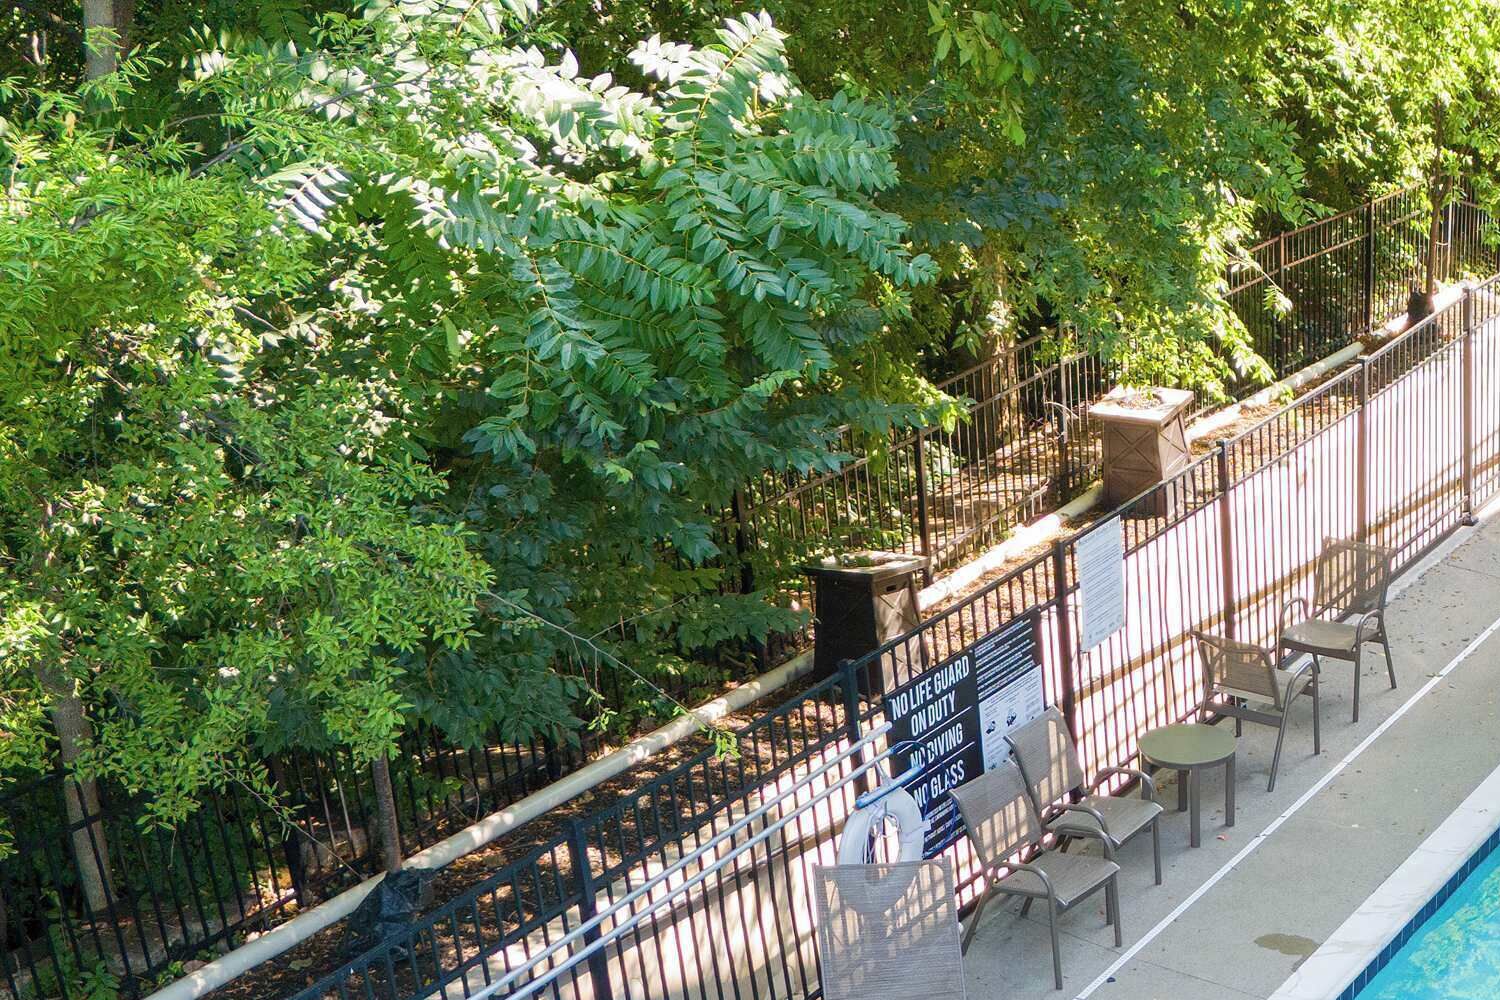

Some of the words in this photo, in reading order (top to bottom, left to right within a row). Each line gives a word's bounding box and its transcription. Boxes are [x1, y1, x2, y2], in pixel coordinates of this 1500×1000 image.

[891, 693, 908, 721] NO
[909, 678, 933, 709] LIFE
[934, 655, 970, 696] GUARD
[911, 708, 927, 737] ON
[928, 690, 956, 728] DUTY
[910, 747, 926, 769] NO
[927, 722, 964, 767] DIVING
[913, 783, 929, 808] NO
[930, 760, 965, 800] GLASS
